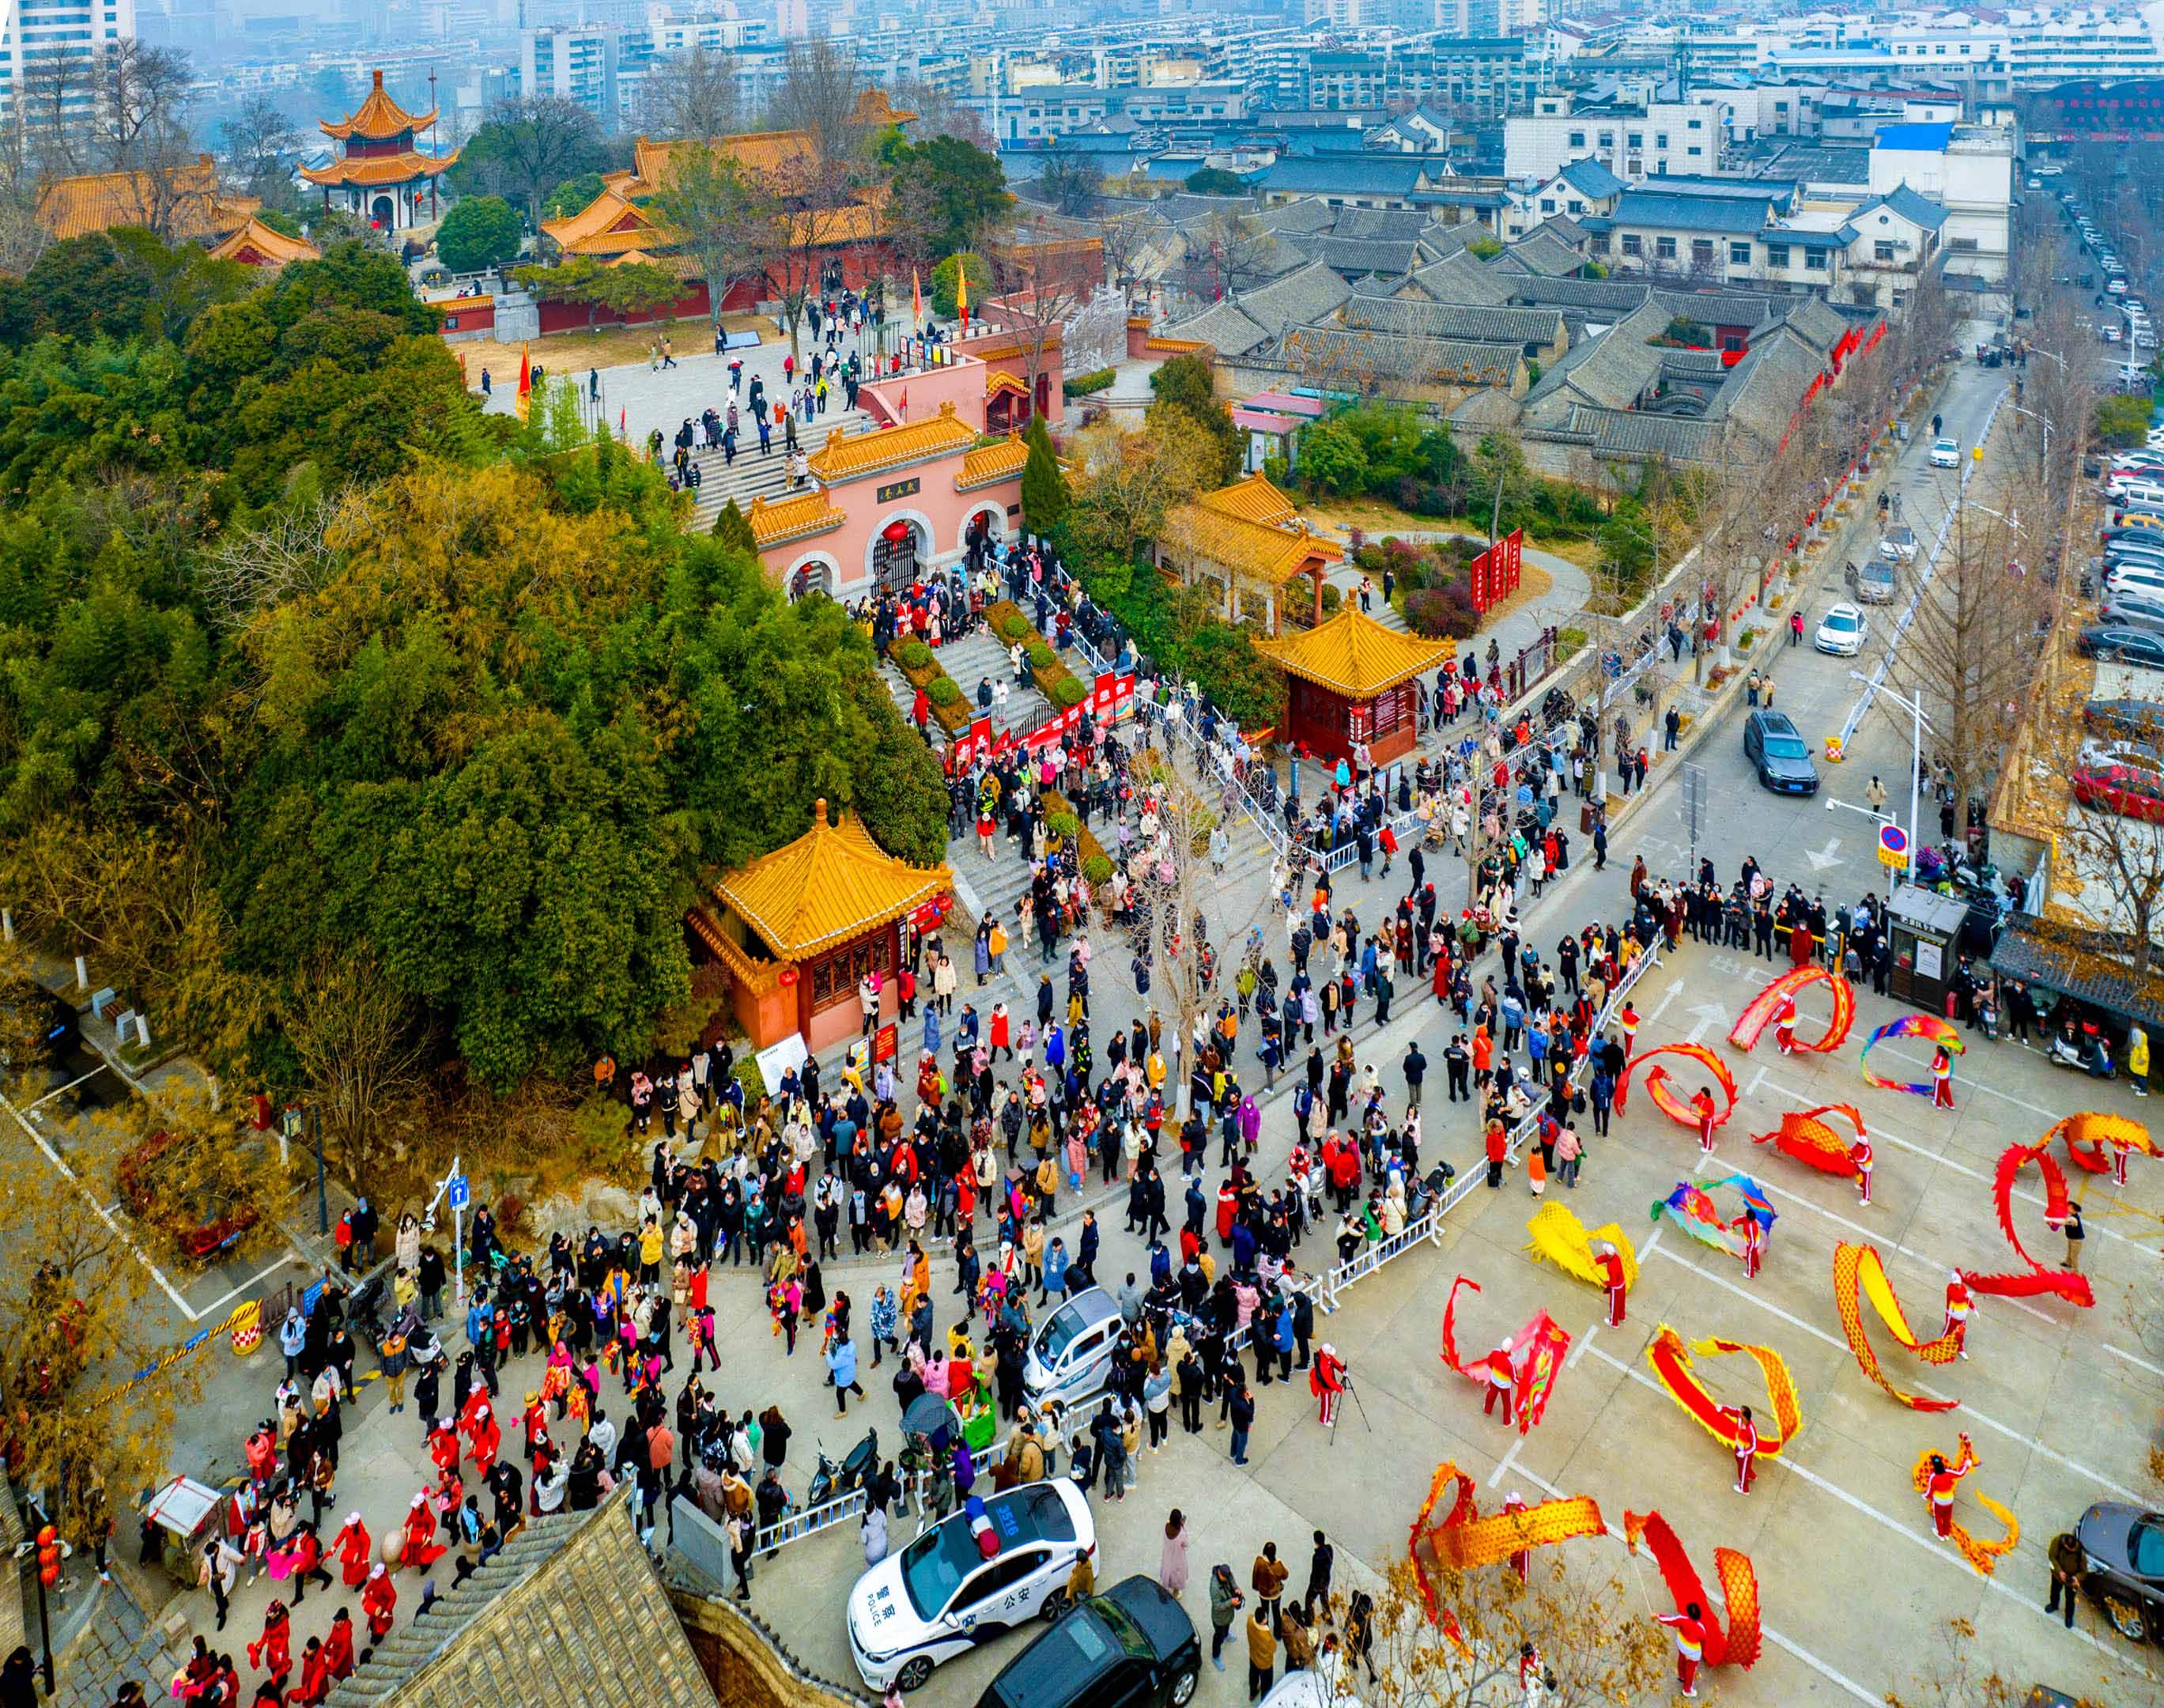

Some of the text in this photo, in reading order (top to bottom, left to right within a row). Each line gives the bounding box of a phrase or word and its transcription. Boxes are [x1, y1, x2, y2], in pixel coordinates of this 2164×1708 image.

[867, 1593, 882, 1627] POLICE
[877, 1585, 896, 1619] 警察
[1003, 1587, 1029, 1610] 公安
